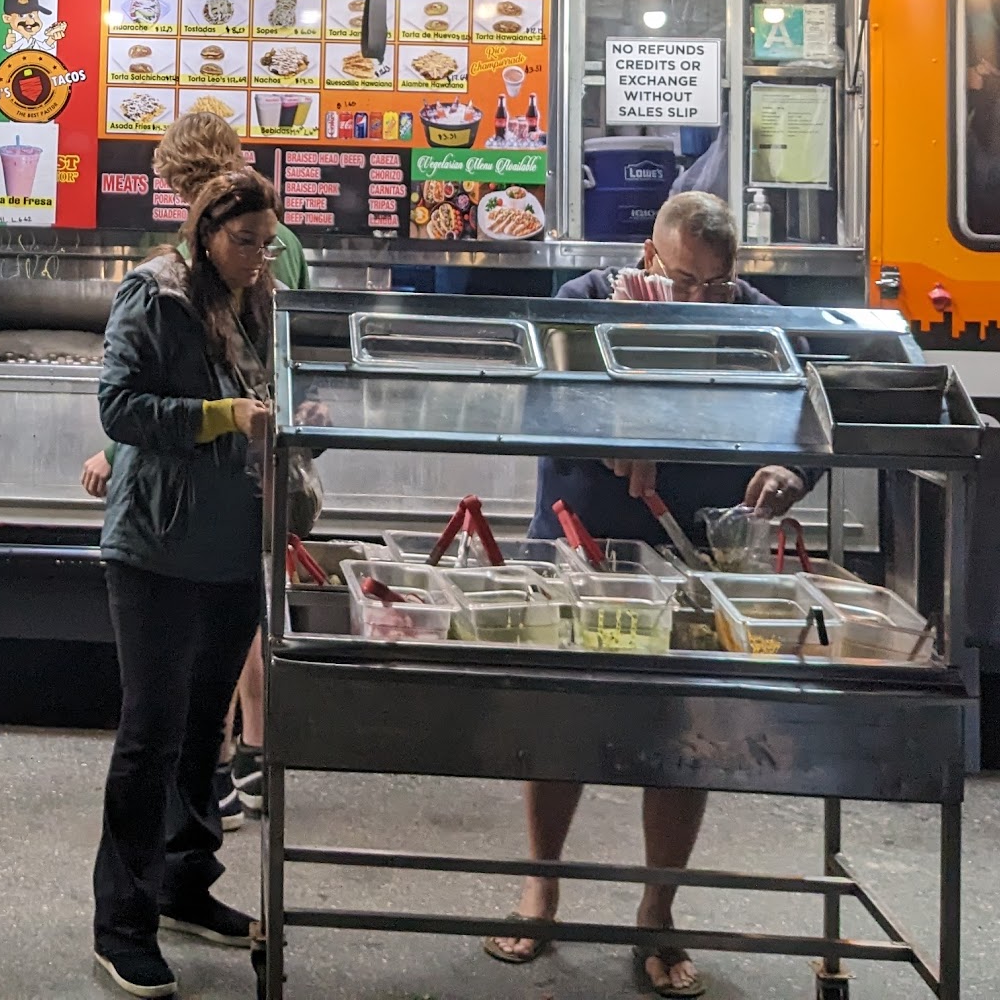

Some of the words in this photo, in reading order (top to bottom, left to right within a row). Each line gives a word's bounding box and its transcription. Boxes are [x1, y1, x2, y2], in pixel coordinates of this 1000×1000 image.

[184, 25, 216, 33] Tostadas
[256, 27, 278, 35] Sopes
[612, 44, 633, 54] NO
[638, 45, 705, 56] REFUNDS
[616, 59, 675, 70] CREDITS
[680, 60, 701, 71] OR
[52, 69, 86, 87] TACOS
[619, 75, 698, 86] EXCHANGE
[624, 91, 692, 102] WITHOUT
[16, 110, 26, 118] THE
[40, 102, 58, 117] PASTOR
[619, 106, 663, 117] SALES
[667, 107, 698, 118] SLIP
[110, 122, 133, 130] Asada
[286, 152, 318, 164] BRAISED
[319, 153, 339, 165] HEAD
[340, 153, 365, 168] (BEEF)
[370, 154, 400, 166] CABEZA
[416, 153, 464, 177] Vegetarian
[465, 156, 493, 175] Menu
[494, 154, 542, 175] Available
[286, 167, 320, 179] SAUSAGE
[369, 169, 403, 181] CHORIZO
[101, 173, 149, 194] MEATS
[285, 182, 317, 194] BRAISED
[318, 183, 340, 195] PORK
[369, 185, 407, 197] CARNITAS
[8, 196, 20, 204] de
[23, 197, 52, 206] Fresa
[153, 194, 174, 205] PORK
[285, 197, 304, 209] BEEF
[305, 198, 327, 210] TRIPE
[368, 199, 396, 212] TRIPAS
[153, 209, 188, 220] SUADERO
[285, 212, 304, 224] BEEF
[305, 213, 334, 225] TONGUE
